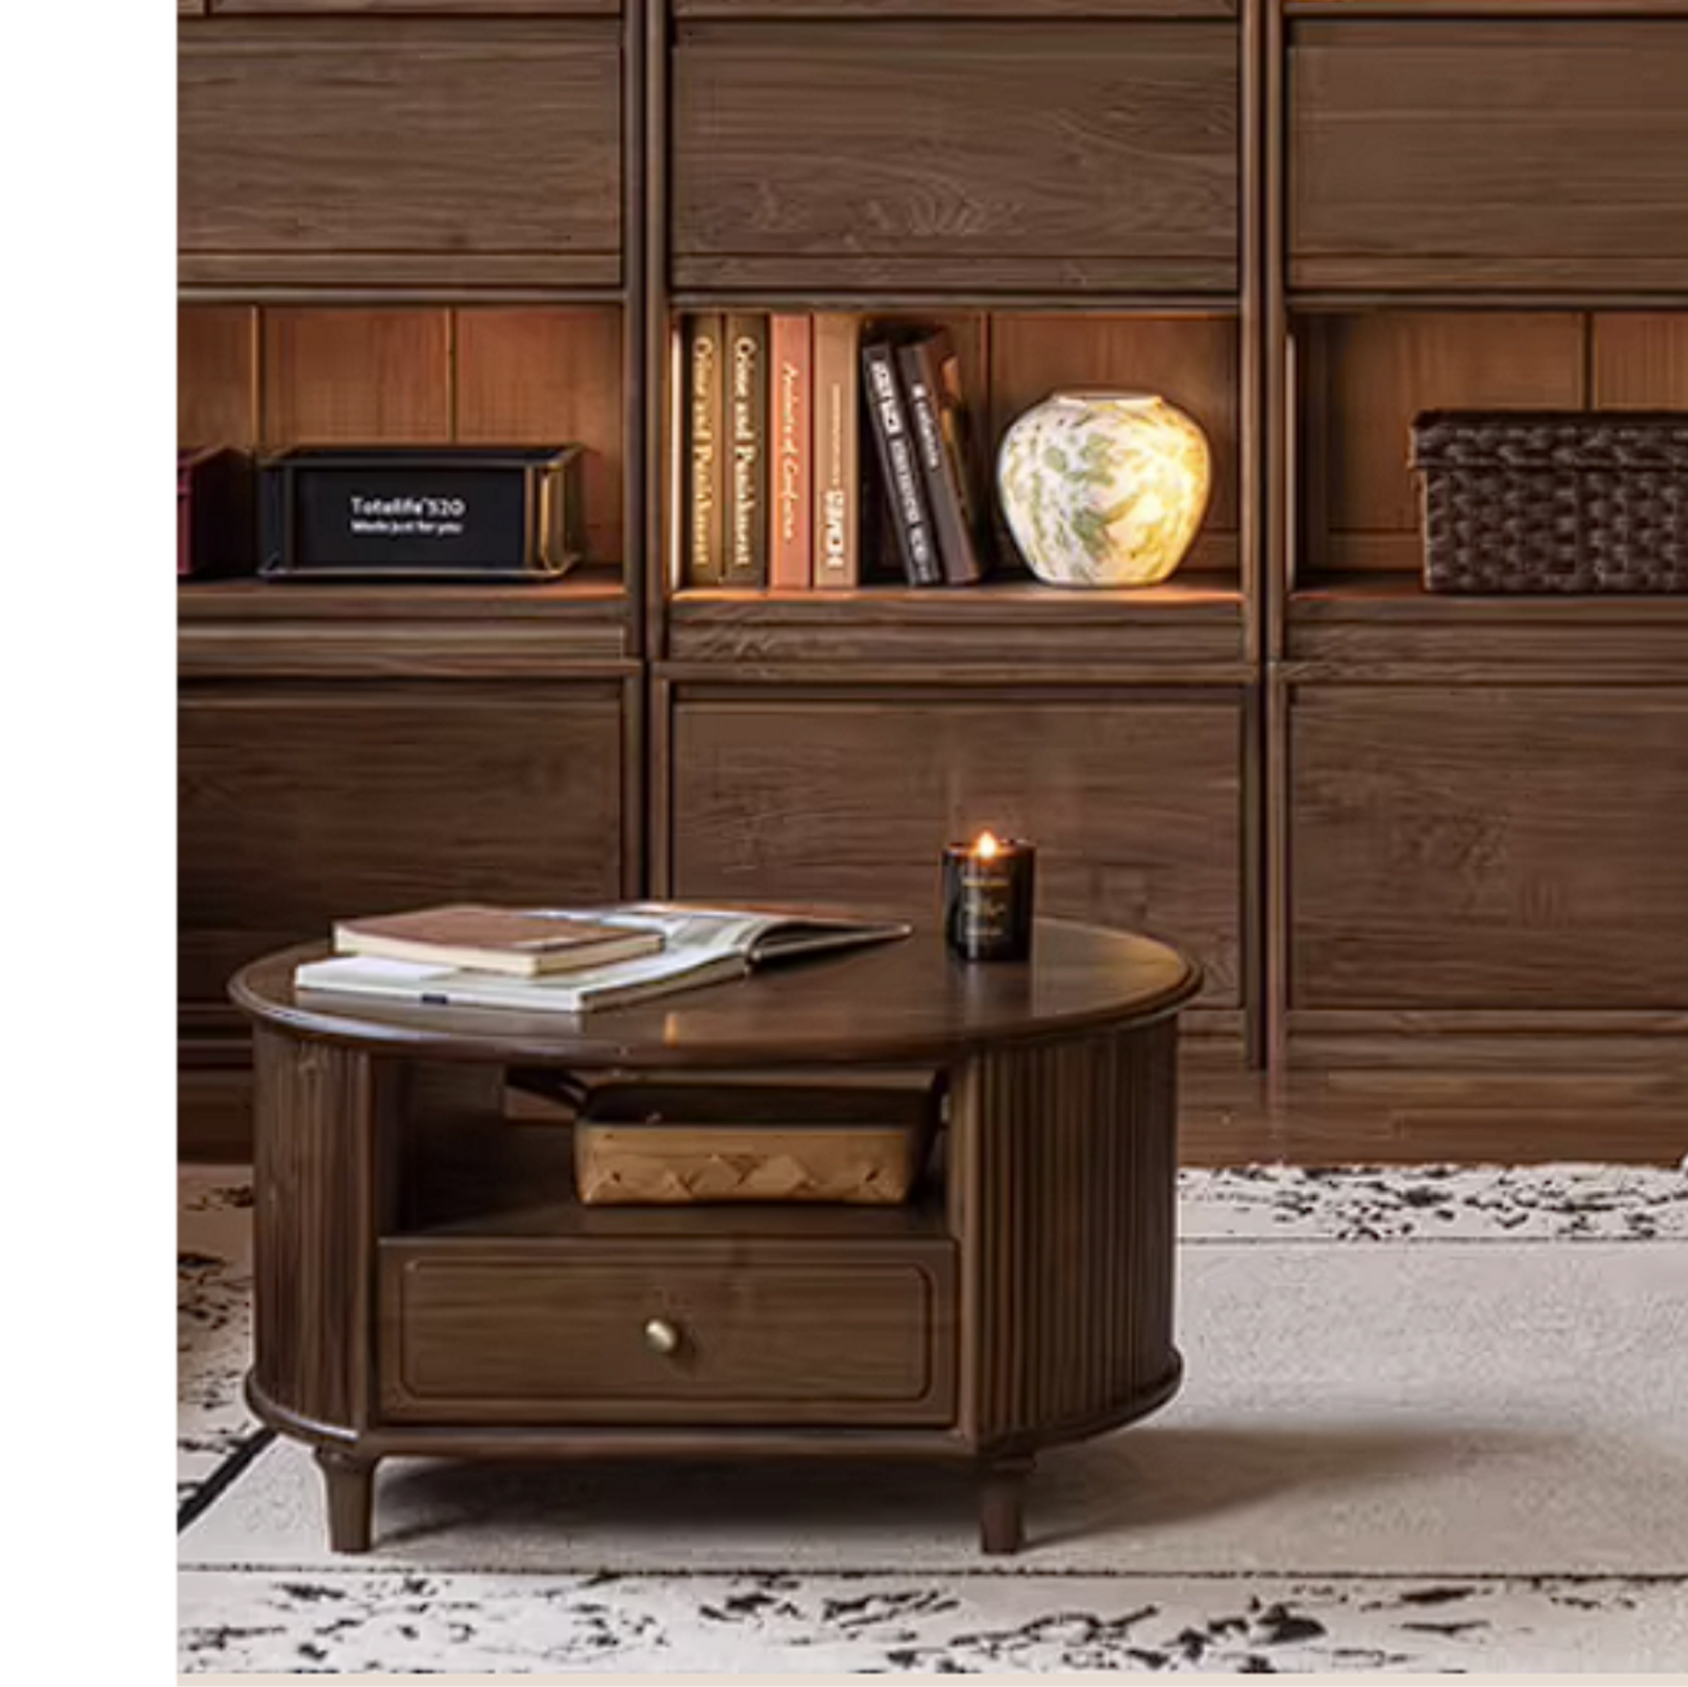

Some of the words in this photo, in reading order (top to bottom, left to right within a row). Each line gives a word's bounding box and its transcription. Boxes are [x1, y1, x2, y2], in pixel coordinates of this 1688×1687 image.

[735, 336, 757, 397] Crime
[735, 402, 756, 439] and
[734, 445, 757, 565] Punishment
